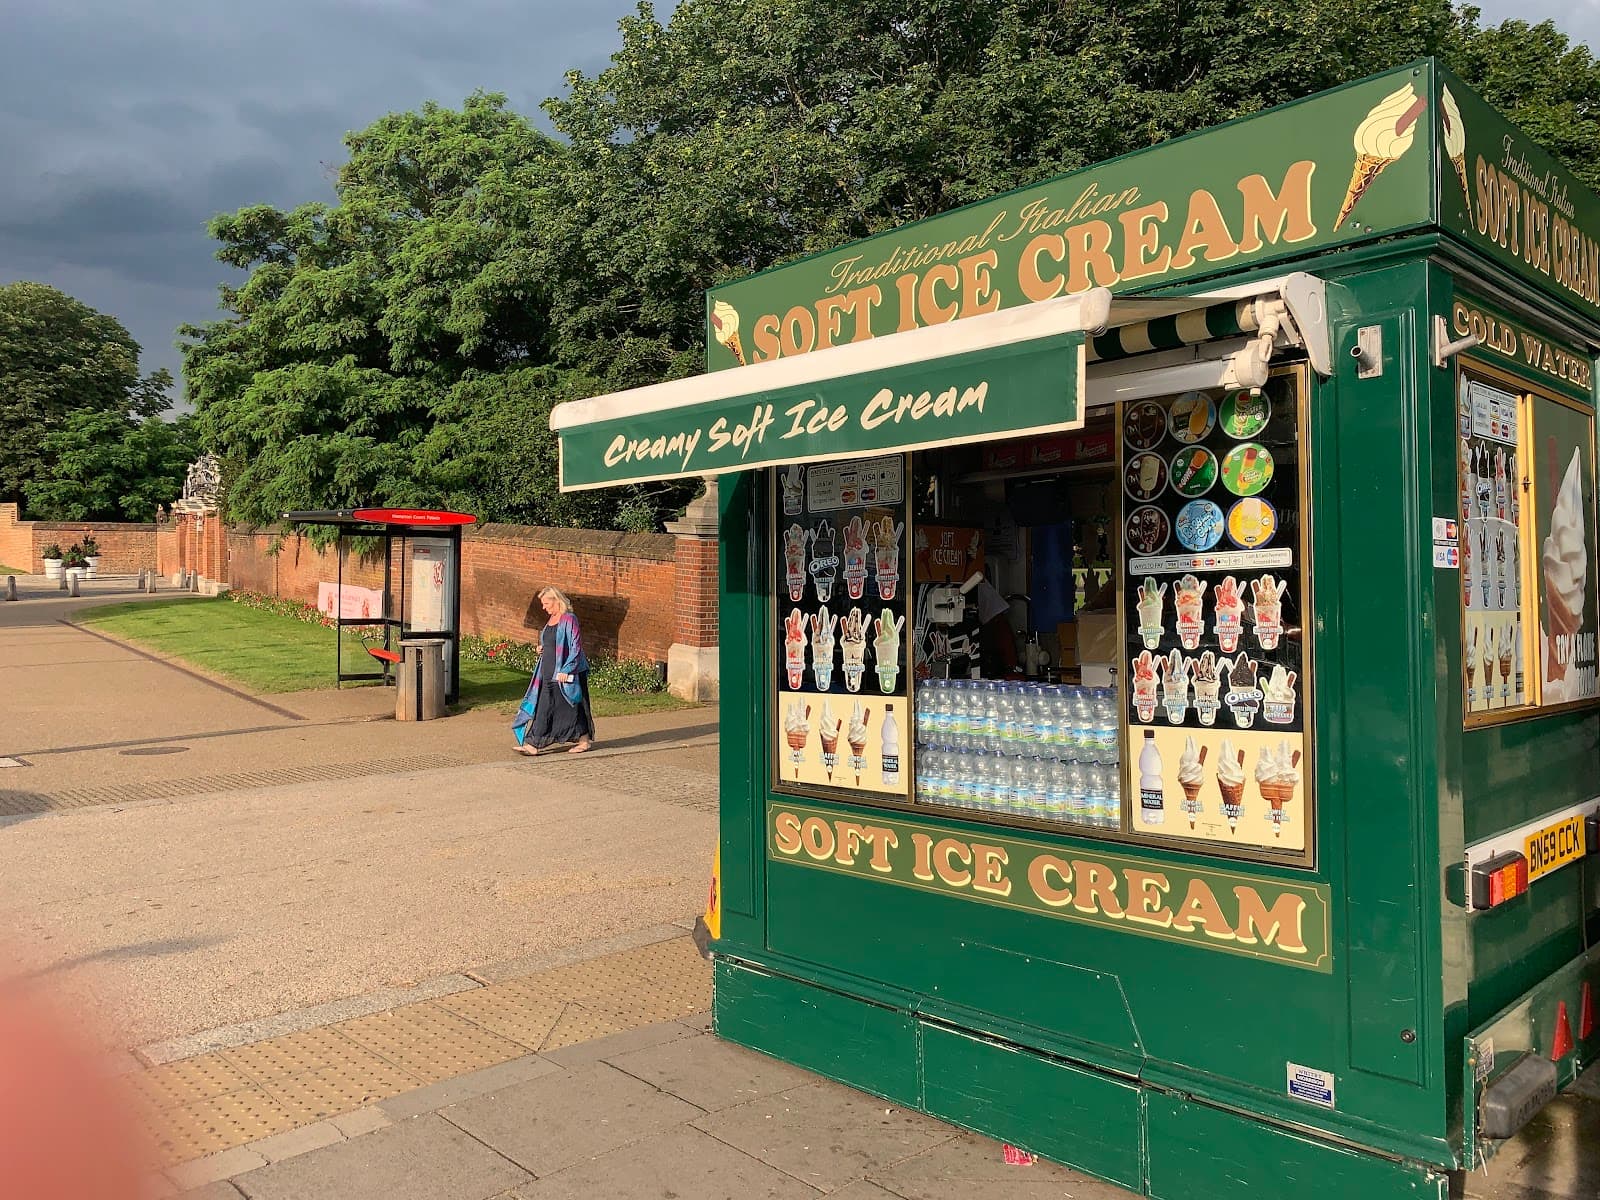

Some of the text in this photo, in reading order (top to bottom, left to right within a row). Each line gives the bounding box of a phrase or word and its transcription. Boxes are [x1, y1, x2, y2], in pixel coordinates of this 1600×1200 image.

[1501, 134, 1575, 220] Traditional Italian
[752, 159, 1318, 364] SOFT ICE CREAM
[824, 182, 1142, 293] Traditional Italian
[1475, 153, 1600, 308] SOFT ICE CREAM
[1453, 301, 1593, 392] COLD WATER
[603, 380, 989, 472] Creamy Soft Ice Cream
[861, 473, 876, 482] VISA
[810, 557, 838, 573] OREO
[1556, 633, 1569, 665] TRY
[1570, 633, 1576, 664] A
[1226, 690, 1261, 704] OREO
[1141, 792, 1162, 800] MINERAL
[774, 811, 1308, 955] SOFT ICE CREAM
[1530, 821, 1580, 873] BN59 CCK
